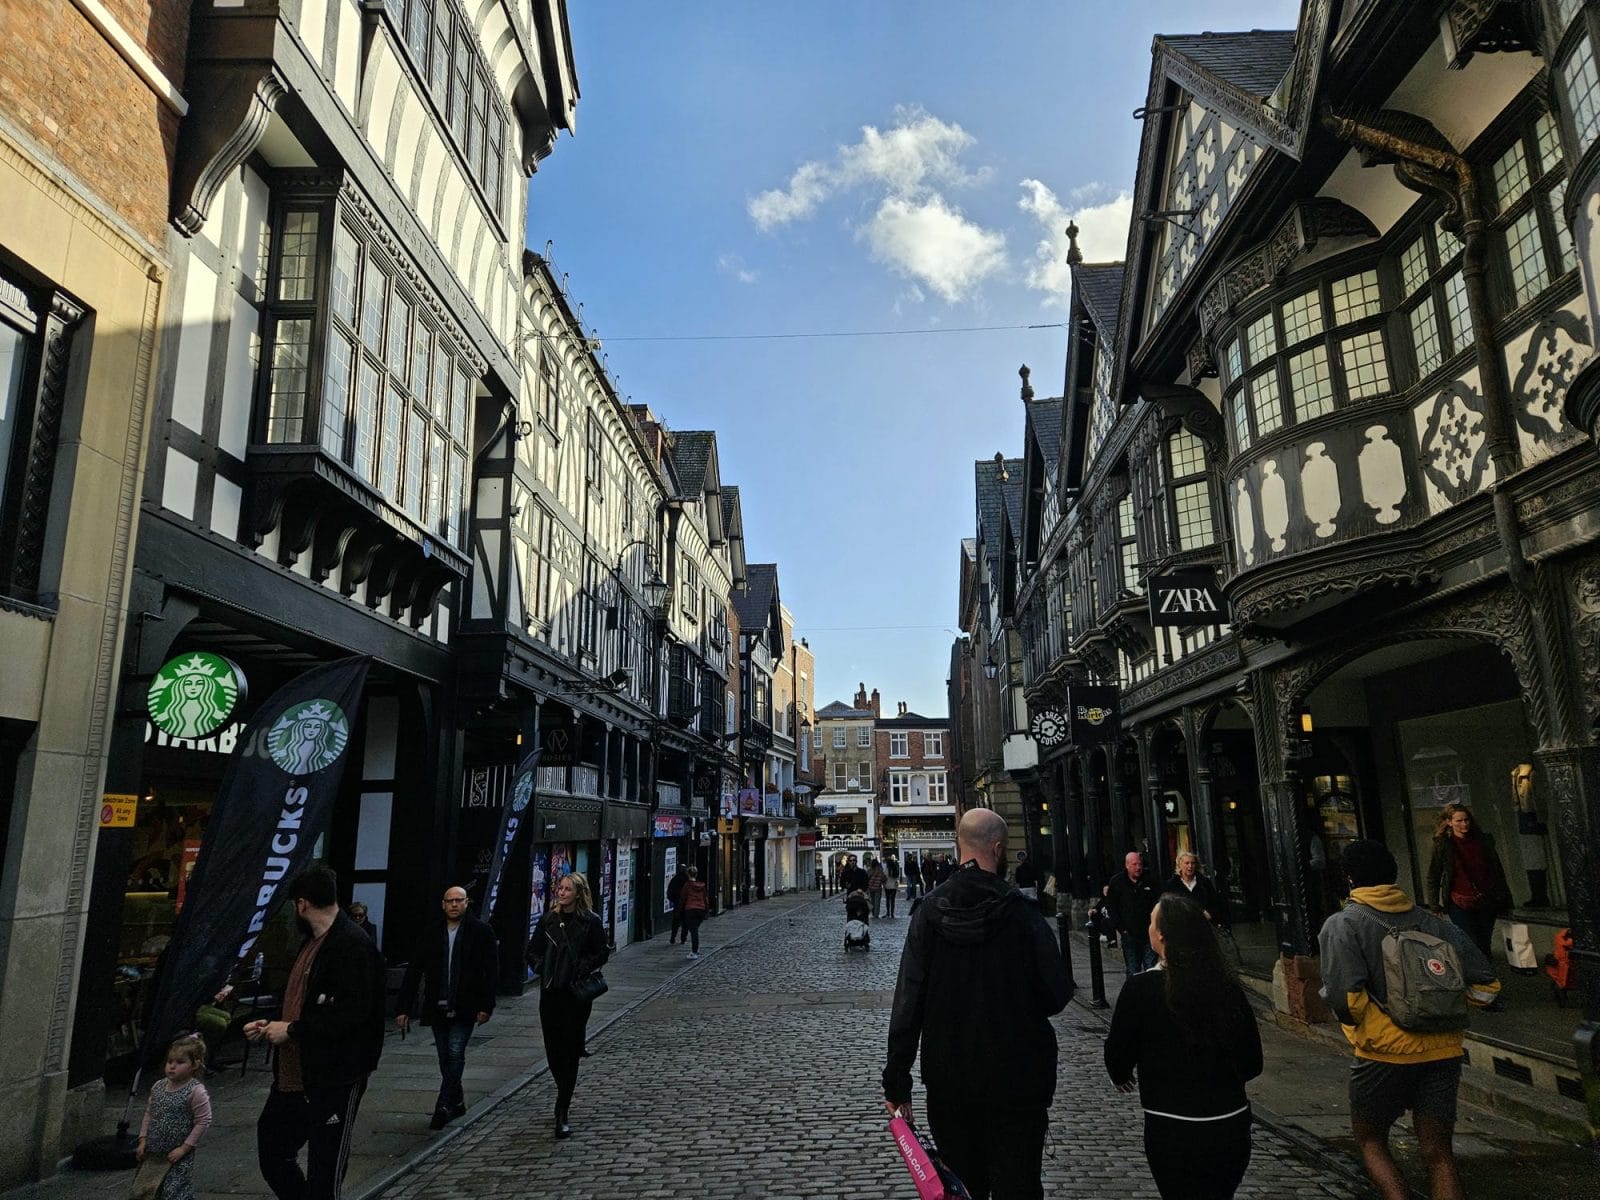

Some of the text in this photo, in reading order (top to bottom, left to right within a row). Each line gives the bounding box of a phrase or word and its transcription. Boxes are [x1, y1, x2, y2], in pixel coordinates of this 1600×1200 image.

[1158, 587, 1219, 614] ZARA
[1031, 710, 1065, 733] BLACK SHEEP
[1040, 730, 1065, 746] COFFEE
[898, 1135, 927, 1181] lush.com
